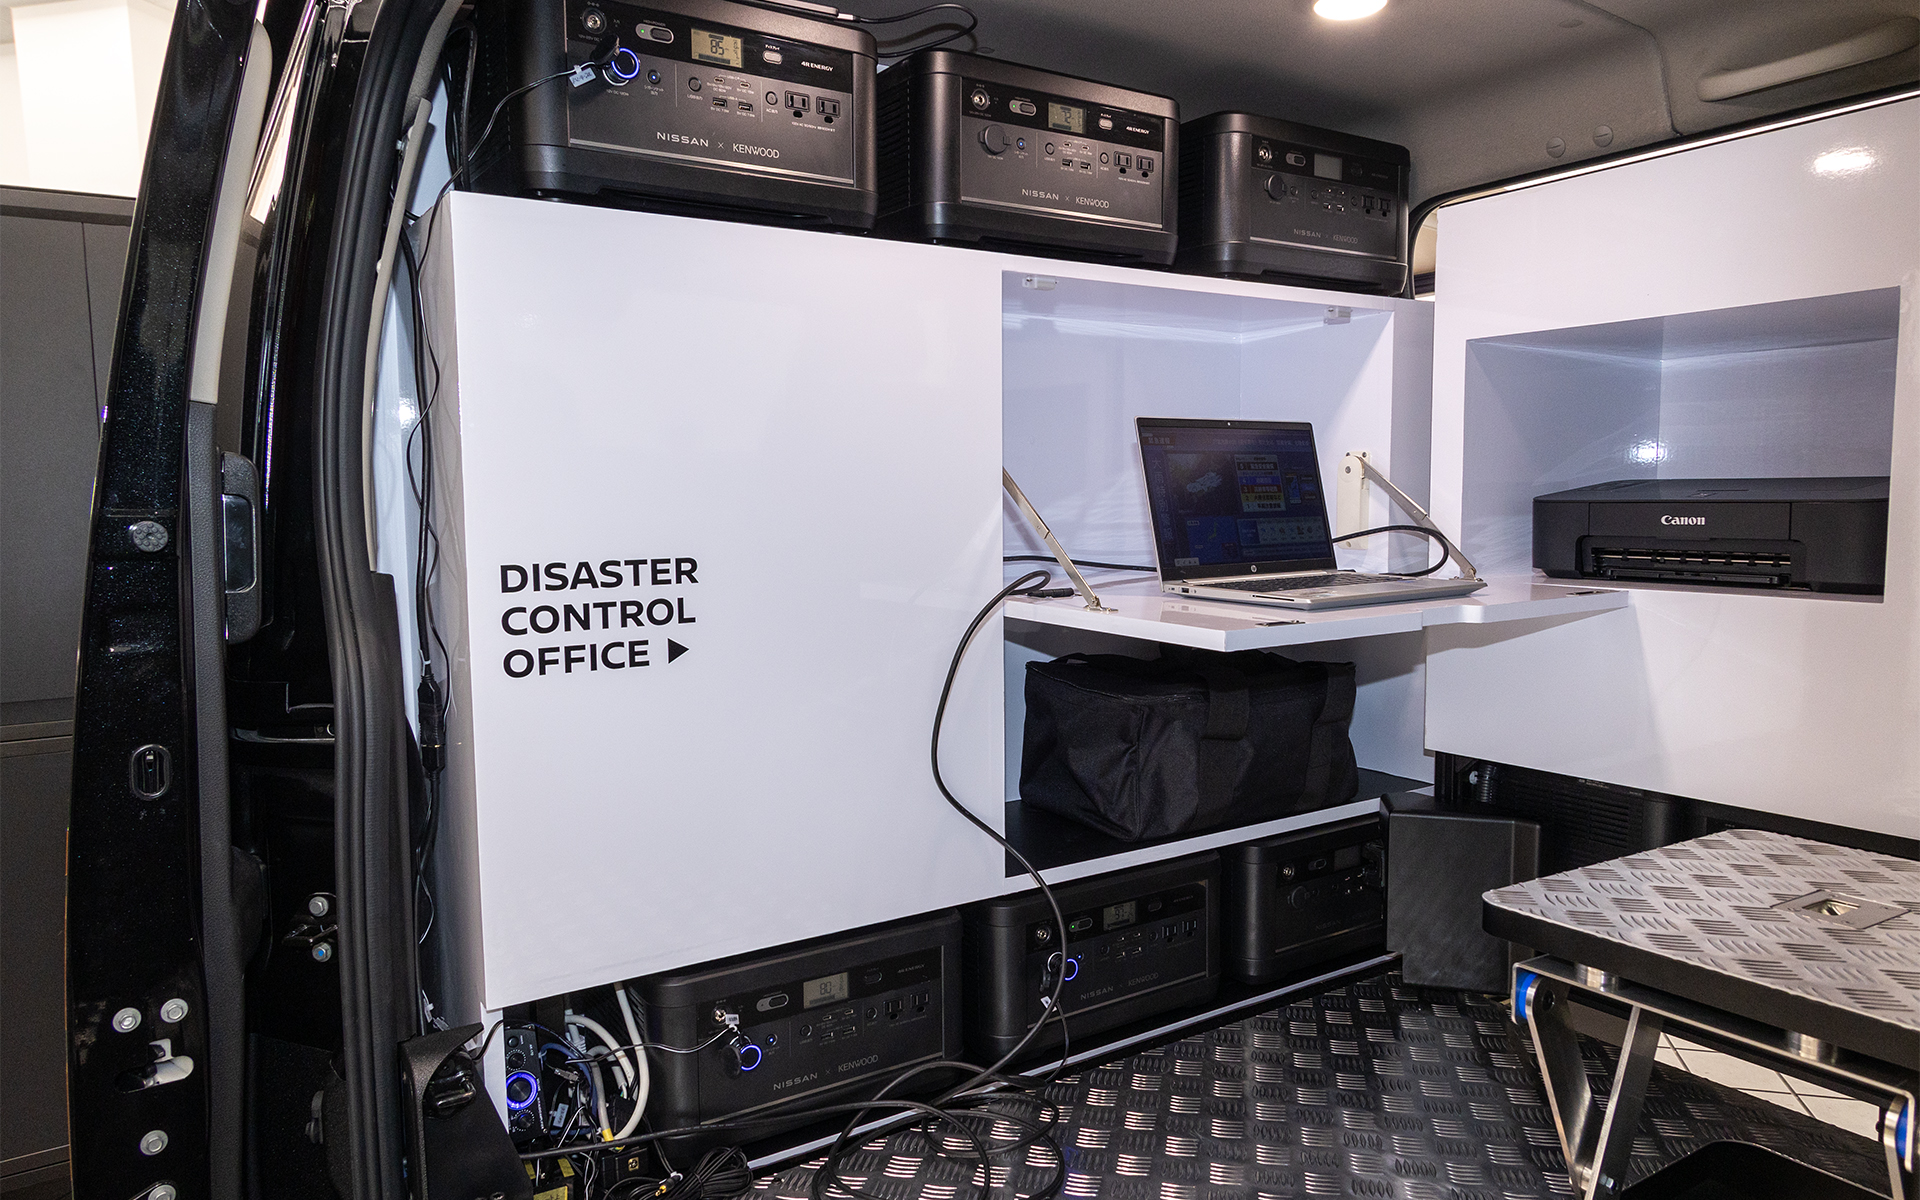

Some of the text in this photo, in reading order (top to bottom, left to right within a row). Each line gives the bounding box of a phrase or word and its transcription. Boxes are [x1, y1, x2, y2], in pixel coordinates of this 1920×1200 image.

[710, 40, 724, 56] 85
[811, 62, 834, 72] ENERGY
[656, 131, 709, 147] NISSAN
[732, 143, 780, 159] KENWOOD
[1022, 188, 1059, 200] NISSAN
[1076, 196, 1109, 209] KENWOOD
[1293, 228, 1358, 244] NISSAN KENWOOD
[1661, 514, 1706, 526] Canon
[500, 557, 699, 594] DISASTER
[501, 597, 696, 636] CONTROL
[503, 639, 650, 679] OFFICE
[1081, 986, 1114, 1000] NISSAN
[773, 1072, 818, 1091] NISSAN
[838, 1055, 879, 1073] KENWOOD
